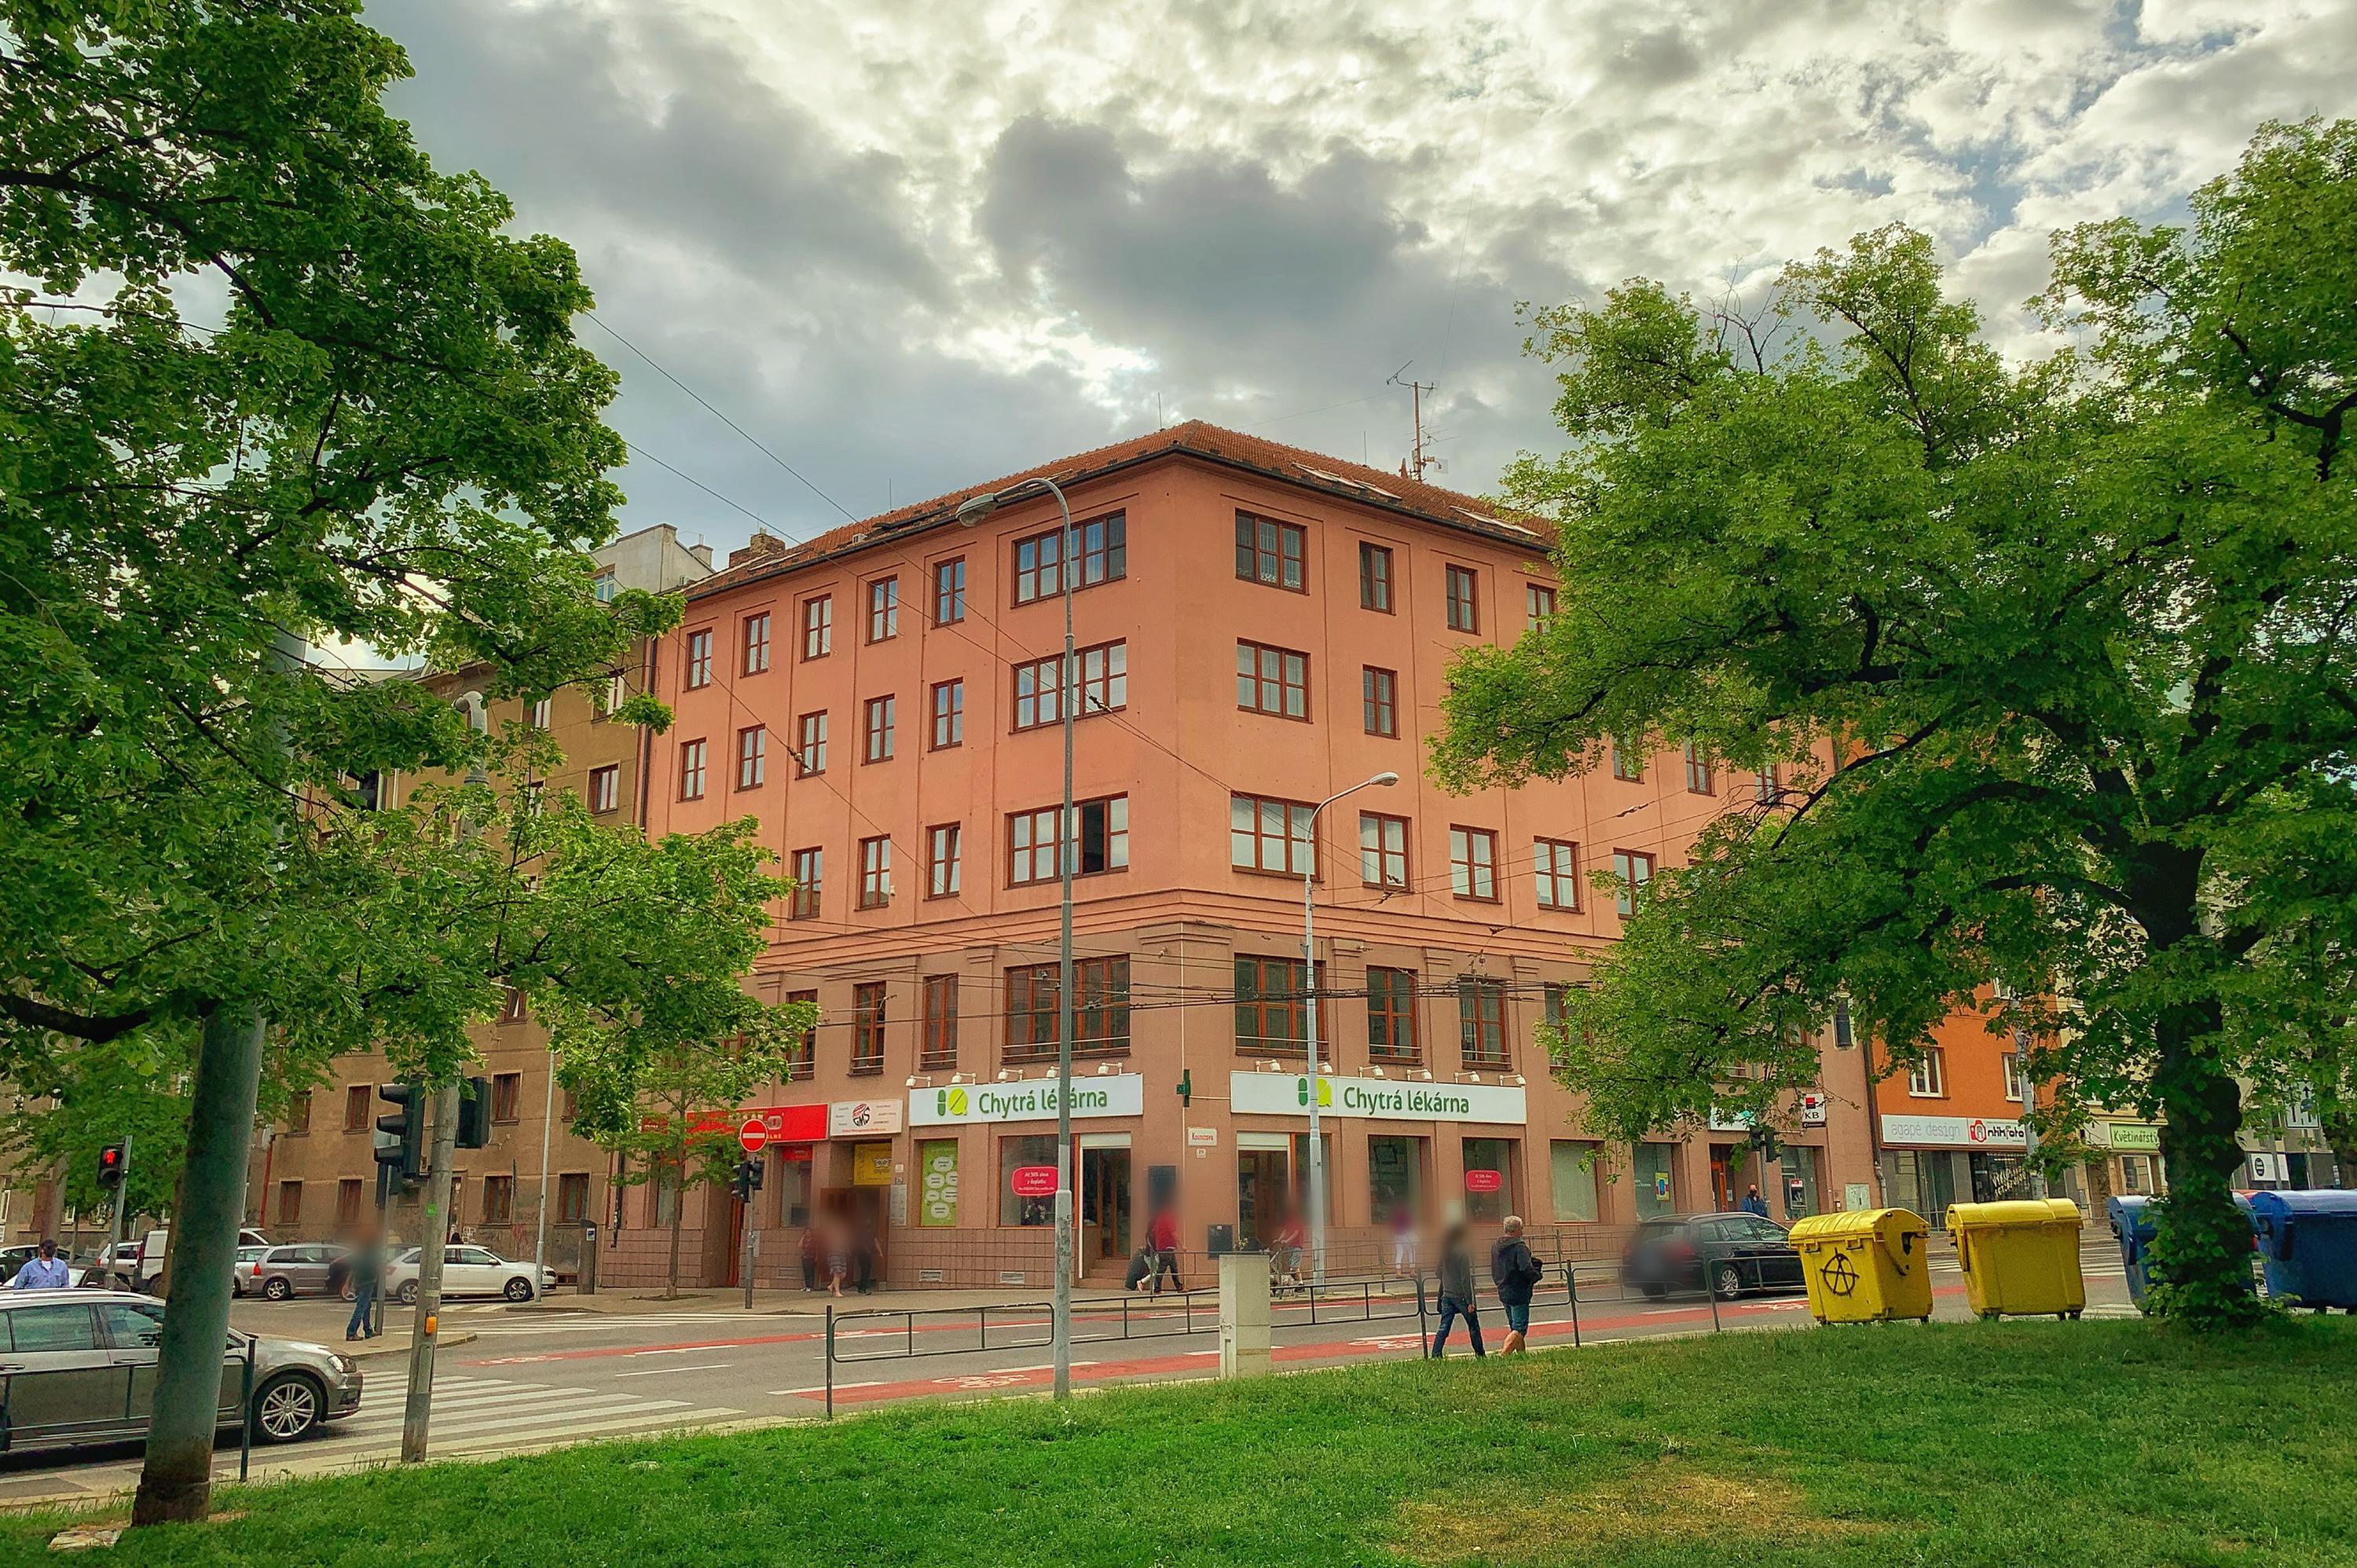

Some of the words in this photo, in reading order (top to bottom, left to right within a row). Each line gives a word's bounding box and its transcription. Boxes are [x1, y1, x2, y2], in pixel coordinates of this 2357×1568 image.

[979, 1090, 1035, 1119] Chytrá
[1041, 1087, 1108, 1111] léárna
[1343, 1087, 1402, 1116] Chytrá
[1408, 1090, 1470, 1113] lékárna
[1804, 1111, 1820, 1120] KB
[1891, 1121, 1923, 1139] agapé
[1926, 1121, 1961, 1141] design
